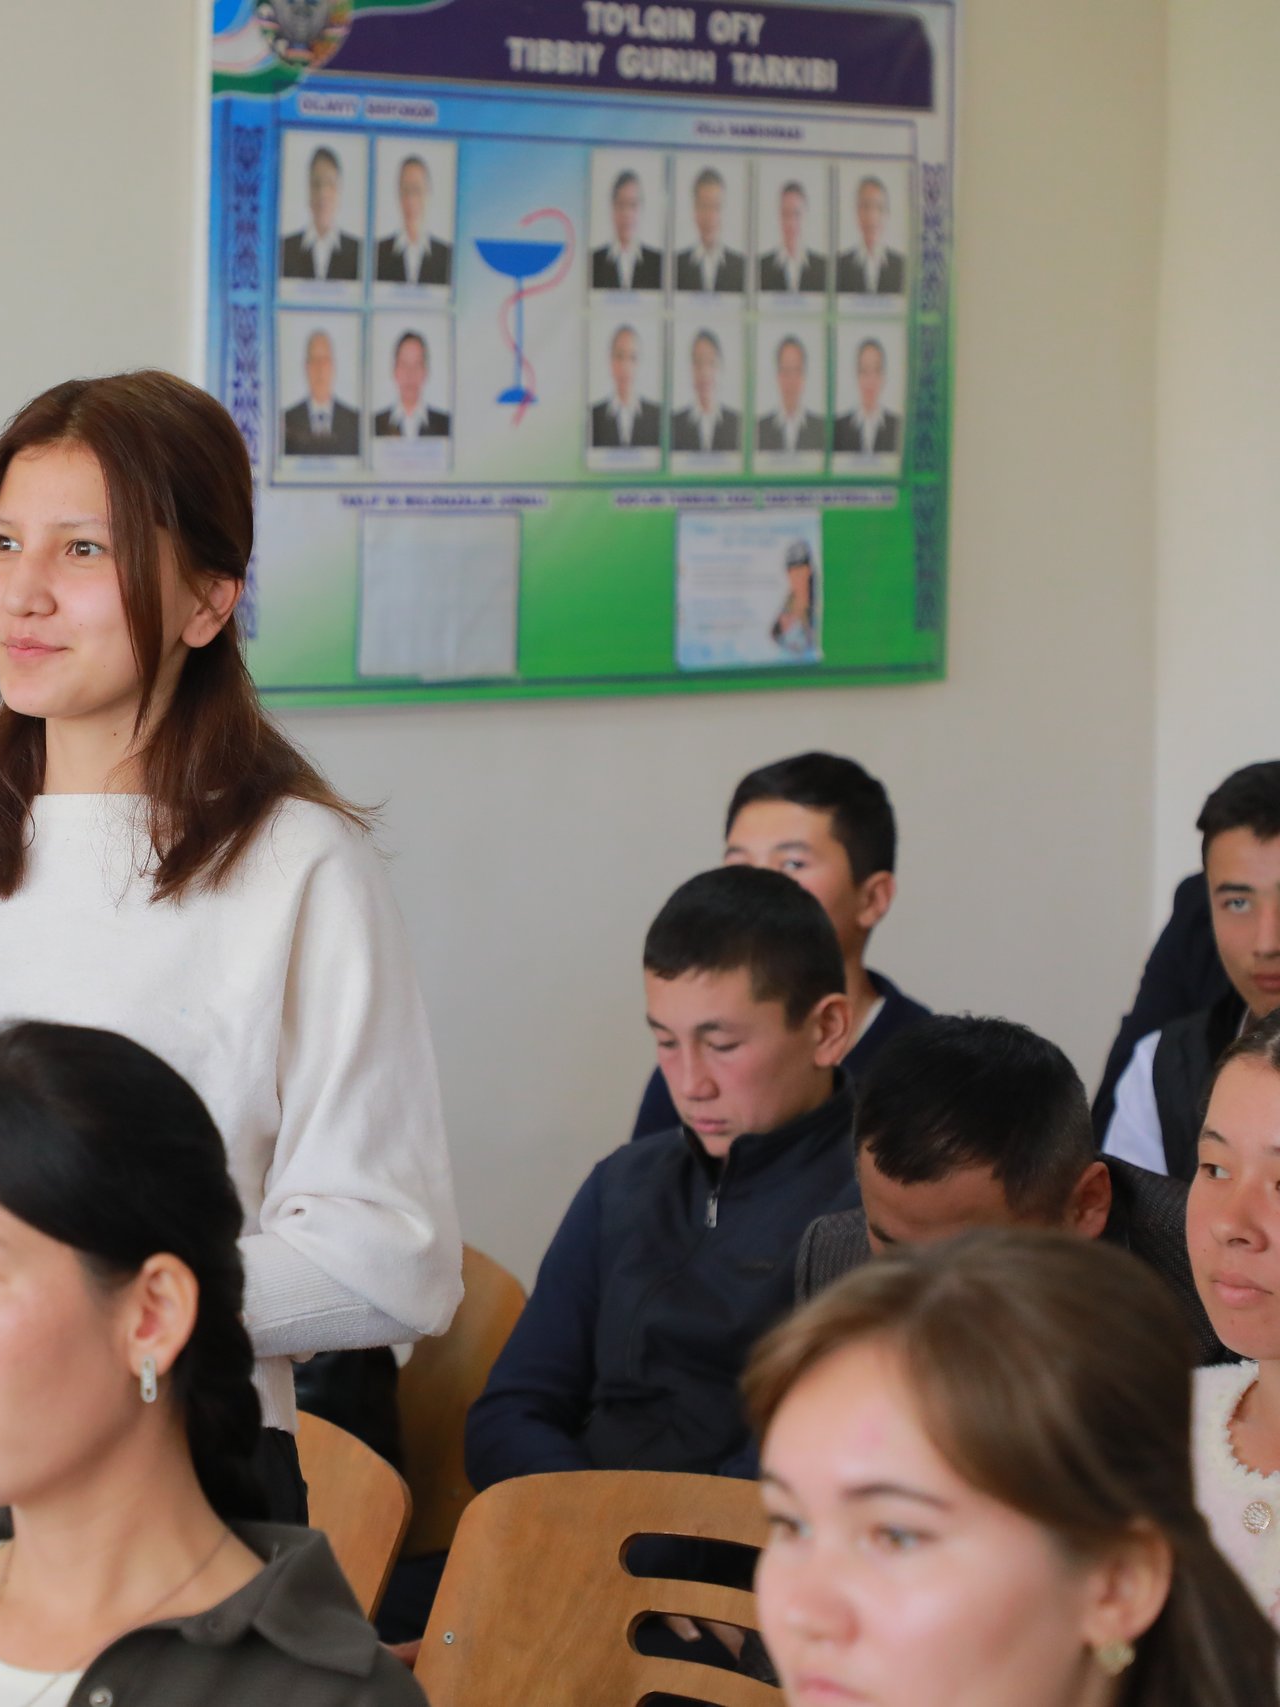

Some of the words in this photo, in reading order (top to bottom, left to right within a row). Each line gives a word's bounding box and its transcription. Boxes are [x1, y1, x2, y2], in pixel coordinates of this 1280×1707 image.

[506, 35, 605, 77] TIBBIY
[616, 43, 717, 84] GURUH
[728, 51, 838, 93] TARKIBI
